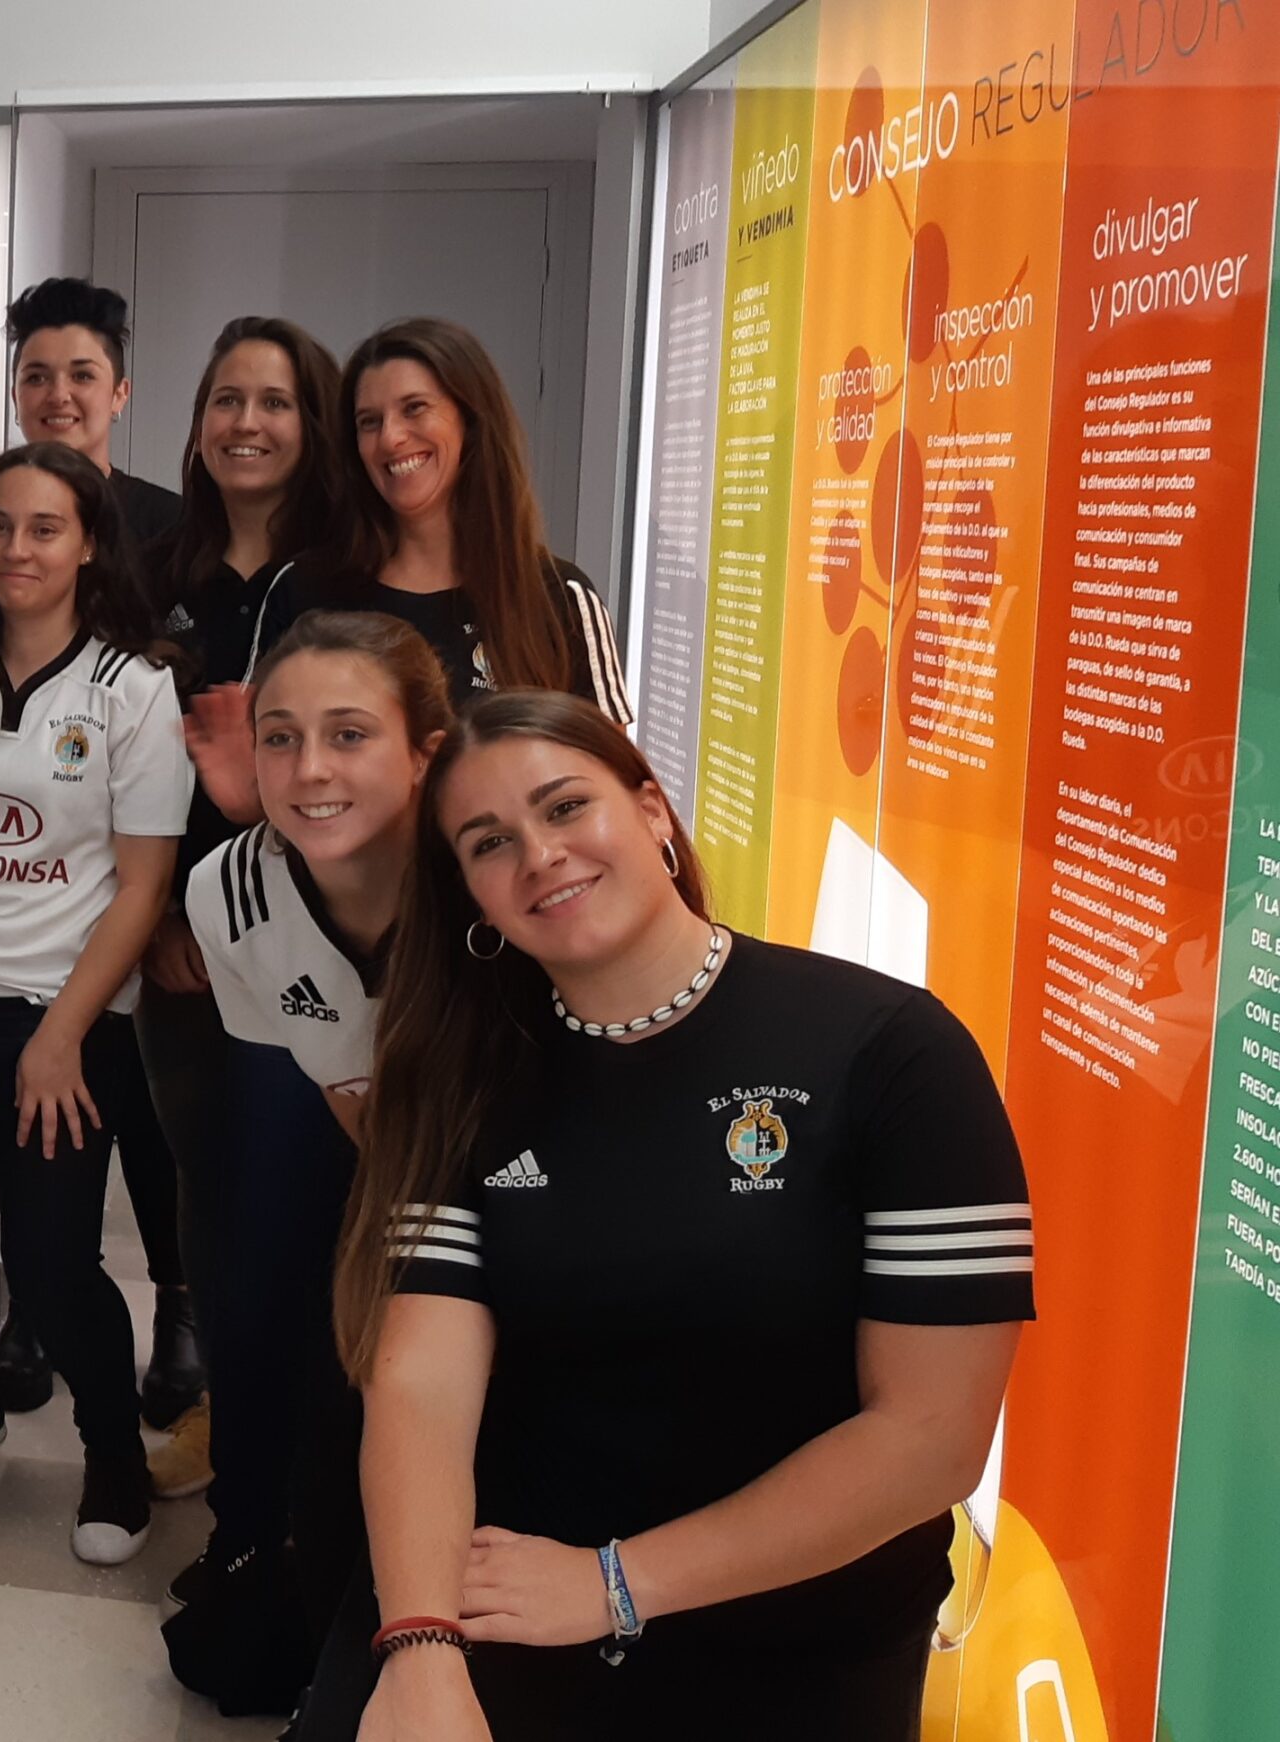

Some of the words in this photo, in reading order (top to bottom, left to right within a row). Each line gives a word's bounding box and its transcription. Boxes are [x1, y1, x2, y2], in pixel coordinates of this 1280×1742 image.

[828, 91, 959, 202] CONSEJO
[972, 0, 1245, 147] REGULADOR
[741, 134, 800, 204] viñedo
[674, 183, 719, 235] contra
[737, 227, 745, 247] Y
[746, 205, 794, 243] VENDIMIA
[1093, 196, 1199, 260] divulgar
[672, 240, 709, 273] ETIQUETA
[1088, 285, 1104, 332] y
[1110, 253, 1248, 328] promover
[934, 285, 1033, 347] inspección
[818, 356, 891, 407] protección
[930, 364, 941, 403] y
[945, 341, 1012, 393] control
[1087, 371, 1100, 385] Una
[1101, 369, 1112, 383] de
[1113, 368, 1124, 382] las
[1124, 362, 1168, 383] principales
[1170, 359, 1210, 375] funciones
[1085, 396, 1096, 411] del
[1097, 394, 1128, 411] Consejo
[1128, 390, 1170, 409] Regulador
[1171, 391, 1181, 404] es
[1182, 391, 1193, 403] su
[816, 417, 825, 450] y
[827, 403, 876, 443] calidad
[1083, 422, 1110, 437] función
[1110, 419, 1154, 438] divulgativa
[1156, 422, 1161, 433] e
[1162, 415, 1211, 432] informativa
[1081, 449, 1090, 463] de
[1092, 449, 1102, 463] las
[1160, 448, 1177, 463] que
[1177, 447, 1210, 460] marcan
[1079, 475, 1086, 489] la
[1141, 474, 1154, 489] del
[1155, 474, 1194, 491] producto
[1078, 502, 1097, 515] hacia
[1152, 502, 1183, 517] medios
[1183, 502, 1195, 518] de
[1128, 534, 1133, 546] y
[1134, 530, 1182, 546] consumidor
[1074, 552, 1091, 567] final.
[1093, 553, 1106, 568] Sus
[1106, 556, 1146, 572] campañas
[1147, 557, 1158, 572] de
[1123, 586, 1133, 598] se
[1134, 586, 1165, 601] centran
[1166, 590, 1177, 602] en
[1071, 605, 1105, 621] transmitir
[1106, 611, 1121, 623] una
[1122, 610, 1151, 629] imagen
[1152, 614, 1164, 629] de
[1164, 618, 1191, 633] marca
[1069, 630, 1078, 643] de
[1079, 631, 1087, 645] la
[1087, 632, 1103, 647] D.O.
[1105, 634, 1130, 652] Rueda
[1130, 642, 1146, 655] que
[1147, 641, 1168, 658] sirva
[1168, 644, 1180, 660] de
[1067, 657, 1101, 675] paraguas,
[1102, 662, 1113, 676] de
[1113, 665, 1133, 680] sello
[1133, 667, 1145, 682] de
[1145, 672, 1182, 691] garantía,
[1183, 679, 1190, 691] a
[1066, 680, 1075, 694] las
[1076, 683, 1107, 702] distintas
[1108, 692, 1136, 708] marcas
[1137, 695, 1148, 711] de
[1149, 697, 1161, 714] las
[1064, 705, 1094, 726] bodegas
[1095, 716, 1129, 734] acogidas
[1130, 724, 1136, 735] a
[1137, 723, 1145, 738] la
[1146, 725, 1163, 743] D.O.
[1062, 730, 1085, 749] Rueda.
[1058, 781, 1068, 795] En
[1069, 787, 1077, 799] su
[1078, 787, 1098, 805] labor
[1098, 794, 1122, 816] diaria,
[1123, 803, 1131, 817] el
[1107, 824, 1119, 840] de
[1259, 818, 1276, 841] LA
[1055, 832, 1066, 846] del
[1067, 836, 1096, 859] Consejo
[1096, 847, 1137, 874] Regulador
[1138, 863, 1165, 886] dedica
[1254, 892, 1263, 910] Y
[1264, 897, 1280, 917] LA
[1251, 927, 1272, 953] DEL
[1248, 963, 1280, 994] AZÚC
[1245, 1000, 1270, 1027] CON
[1242, 1036, 1259, 1055] NO
[732, 1085, 811, 1106] SALVADOR
[1233, 1143, 1264, 1175] 2.600
[484, 1174, 548, 1188] adidas
[729, 1177, 785, 1192] RUGBY
[1231, 1179, 1270, 1218] SERÍAN
[1227, 1214, 1263, 1252] FUERA
[1225, 1249, 1264, 1291] TARDÍA
